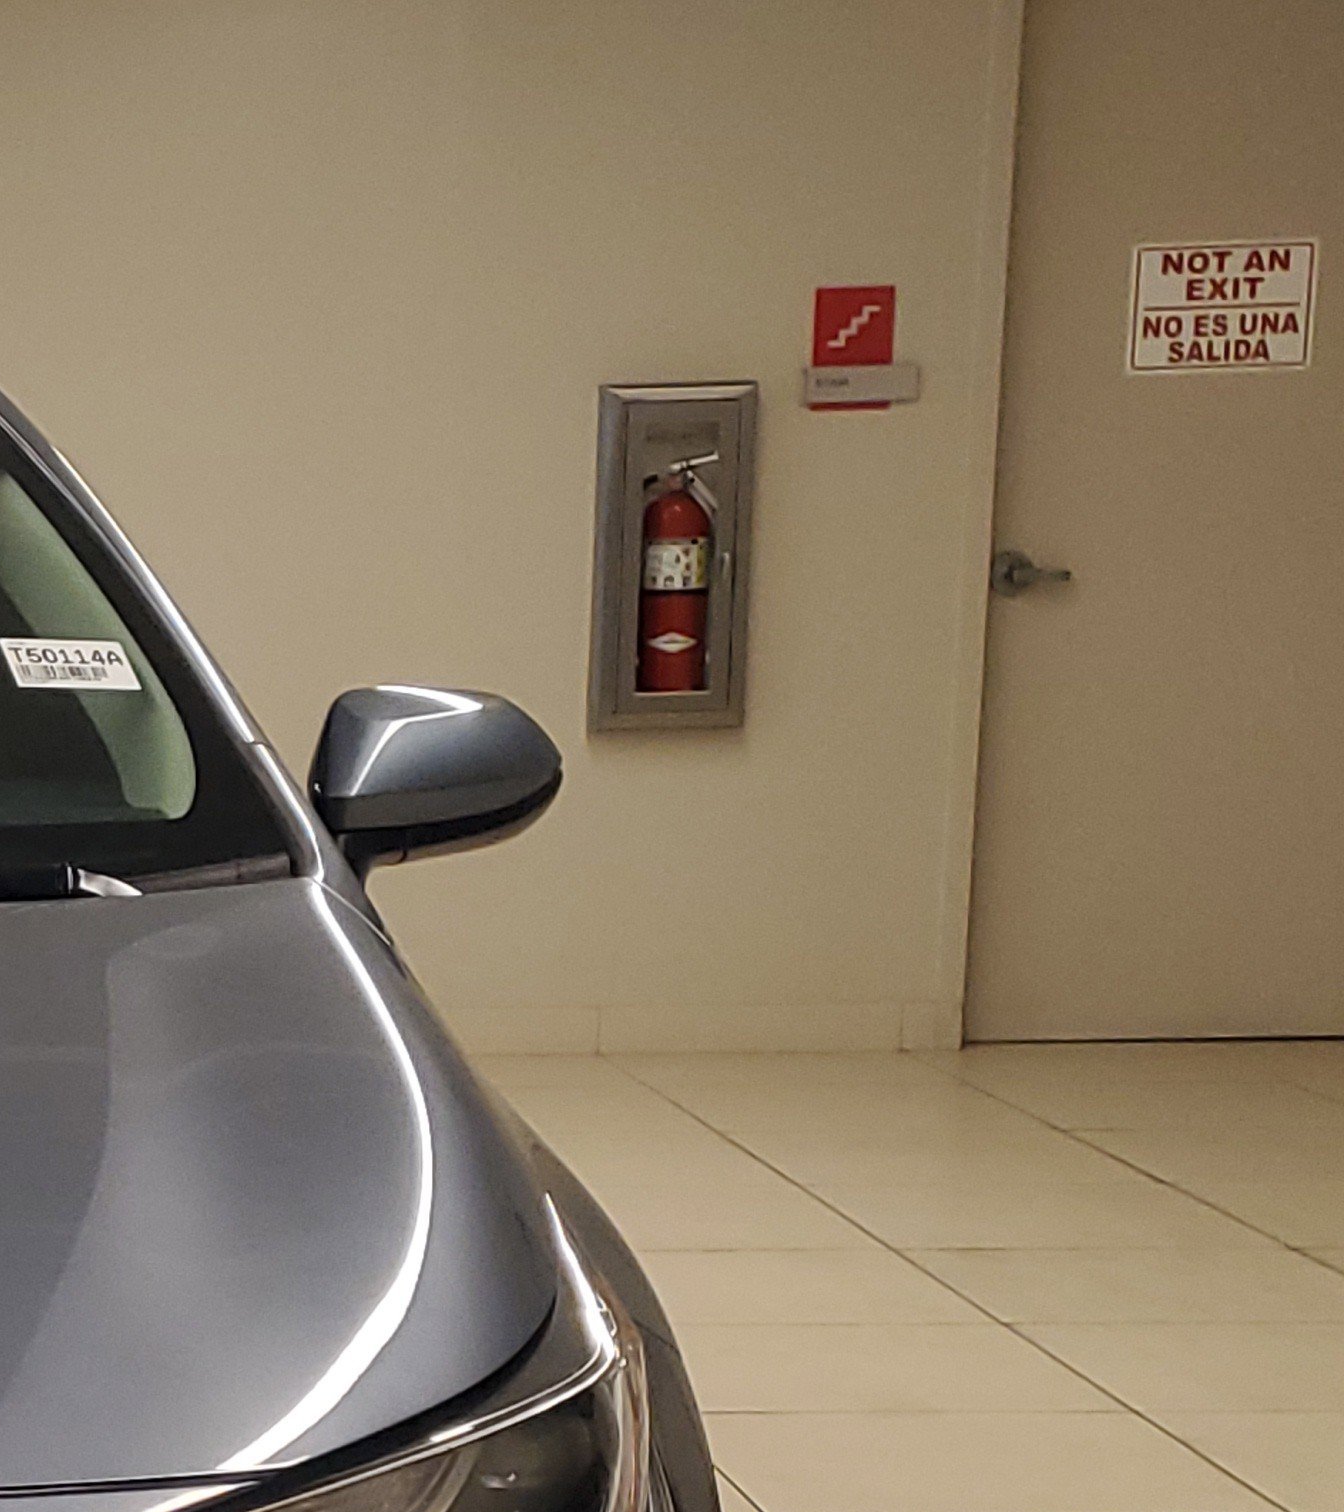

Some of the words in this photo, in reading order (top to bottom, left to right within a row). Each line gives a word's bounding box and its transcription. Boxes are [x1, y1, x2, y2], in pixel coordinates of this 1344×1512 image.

[1162, 251, 1233, 275] NOT
[1243, 249, 1291, 272] AN
[1186, 277, 1264, 300] EXIT
[1142, 315, 1183, 340] NO
[1193, 314, 1228, 337] ES
[1239, 312, 1300, 336] UNA
[1167, 340, 1270, 363] SALIDA
[7, 646, 125, 666] T50114A
